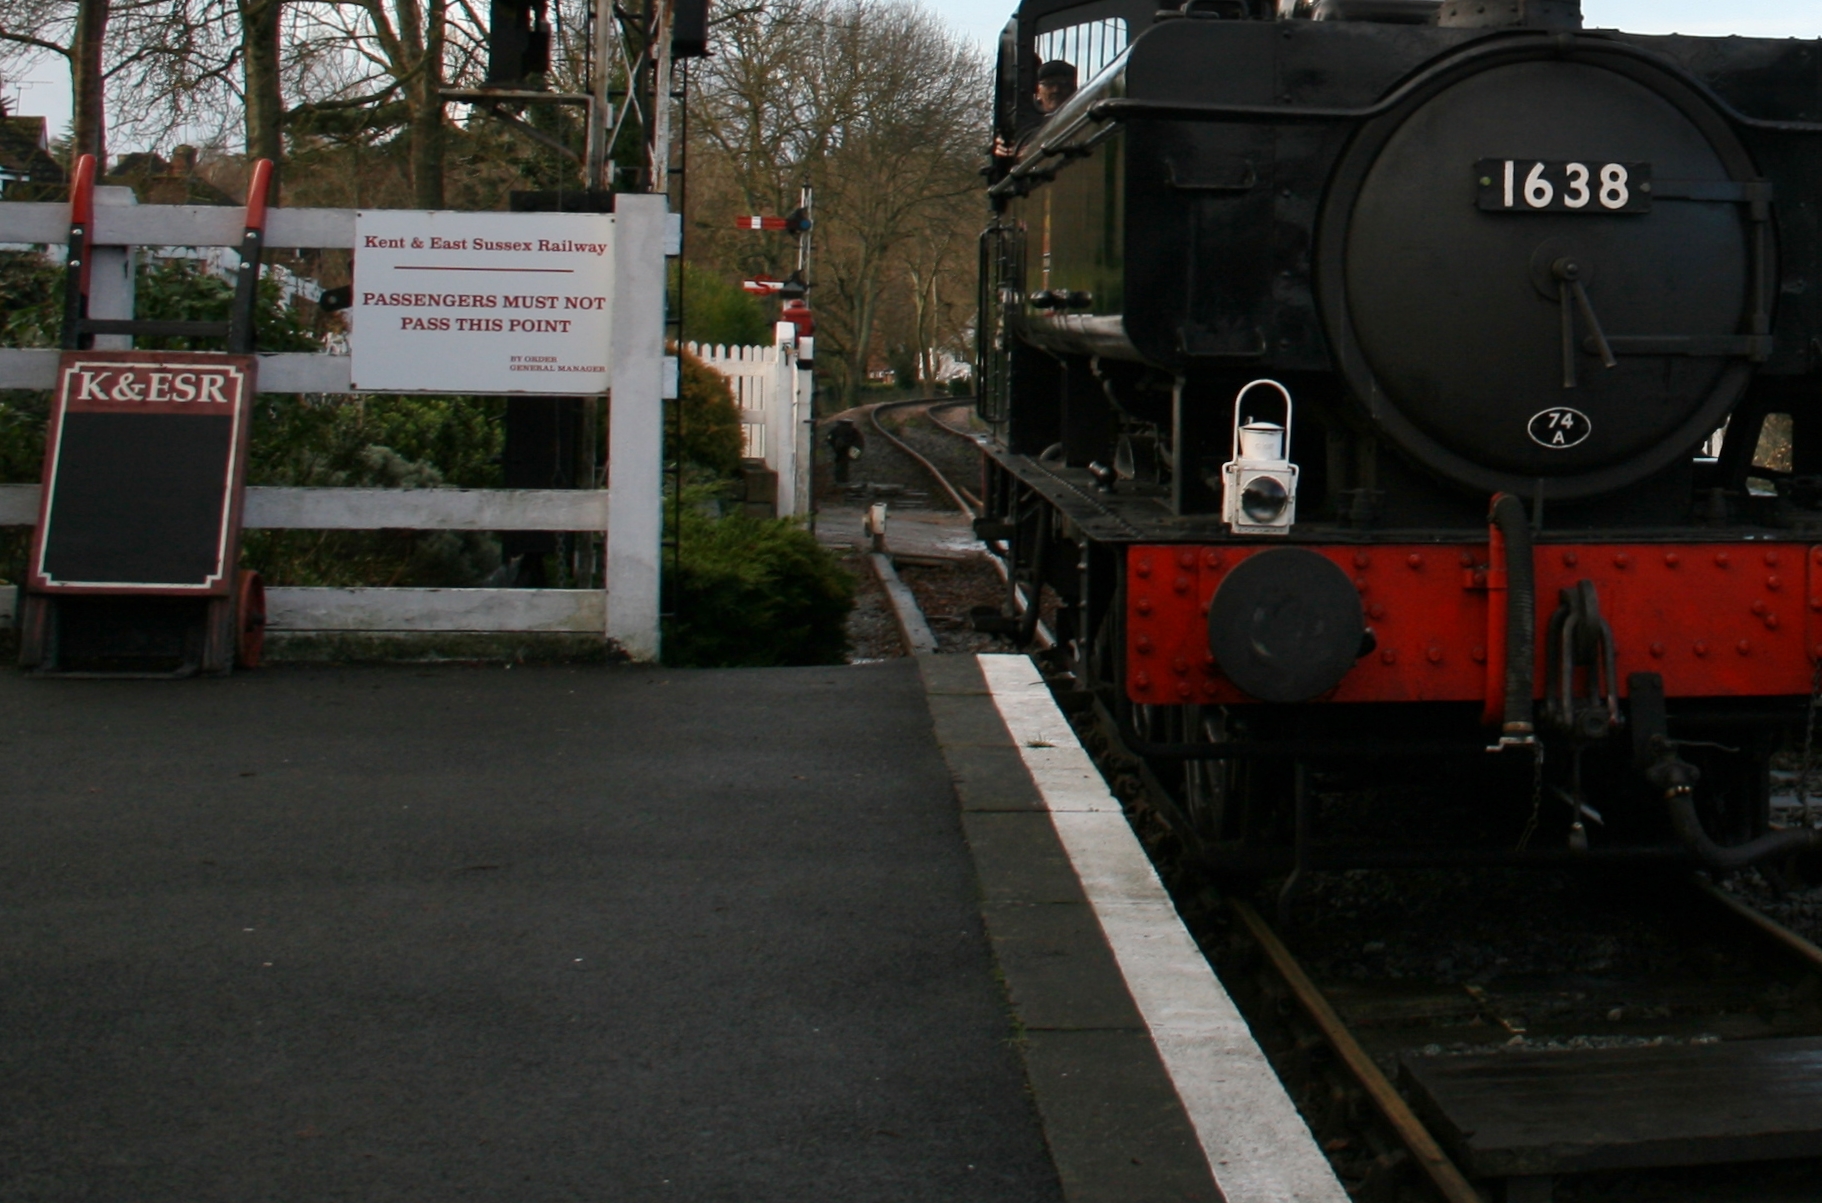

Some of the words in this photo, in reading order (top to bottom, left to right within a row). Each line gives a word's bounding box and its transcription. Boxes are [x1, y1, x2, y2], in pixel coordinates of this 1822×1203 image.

[1503, 160, 1629, 210] 1638
[364, 235, 405, 249] Kent
[411, 236, 424, 249] &
[430, 236, 468, 250] East
[473, 238, 532, 252] Sussex
[538, 239, 607, 256] Railway
[362, 292, 497, 308] PASSENGERS
[502, 295, 559, 309] MUST
[564, 296, 606, 310] NOT
[400, 316, 450, 331] PASS
[456, 317, 503, 332] THIS
[508, 319, 571, 333] POINT
[510, 355, 523, 363] BY
[524, 355, 558, 363] ORDER
[509, 364, 556, 372] GENERAL
[557, 365, 607, 373] MANAGER
[77, 371, 228, 403] K&ESR
[1548, 413, 1574, 430] 74
[1552, 430, 1566, 444] A
